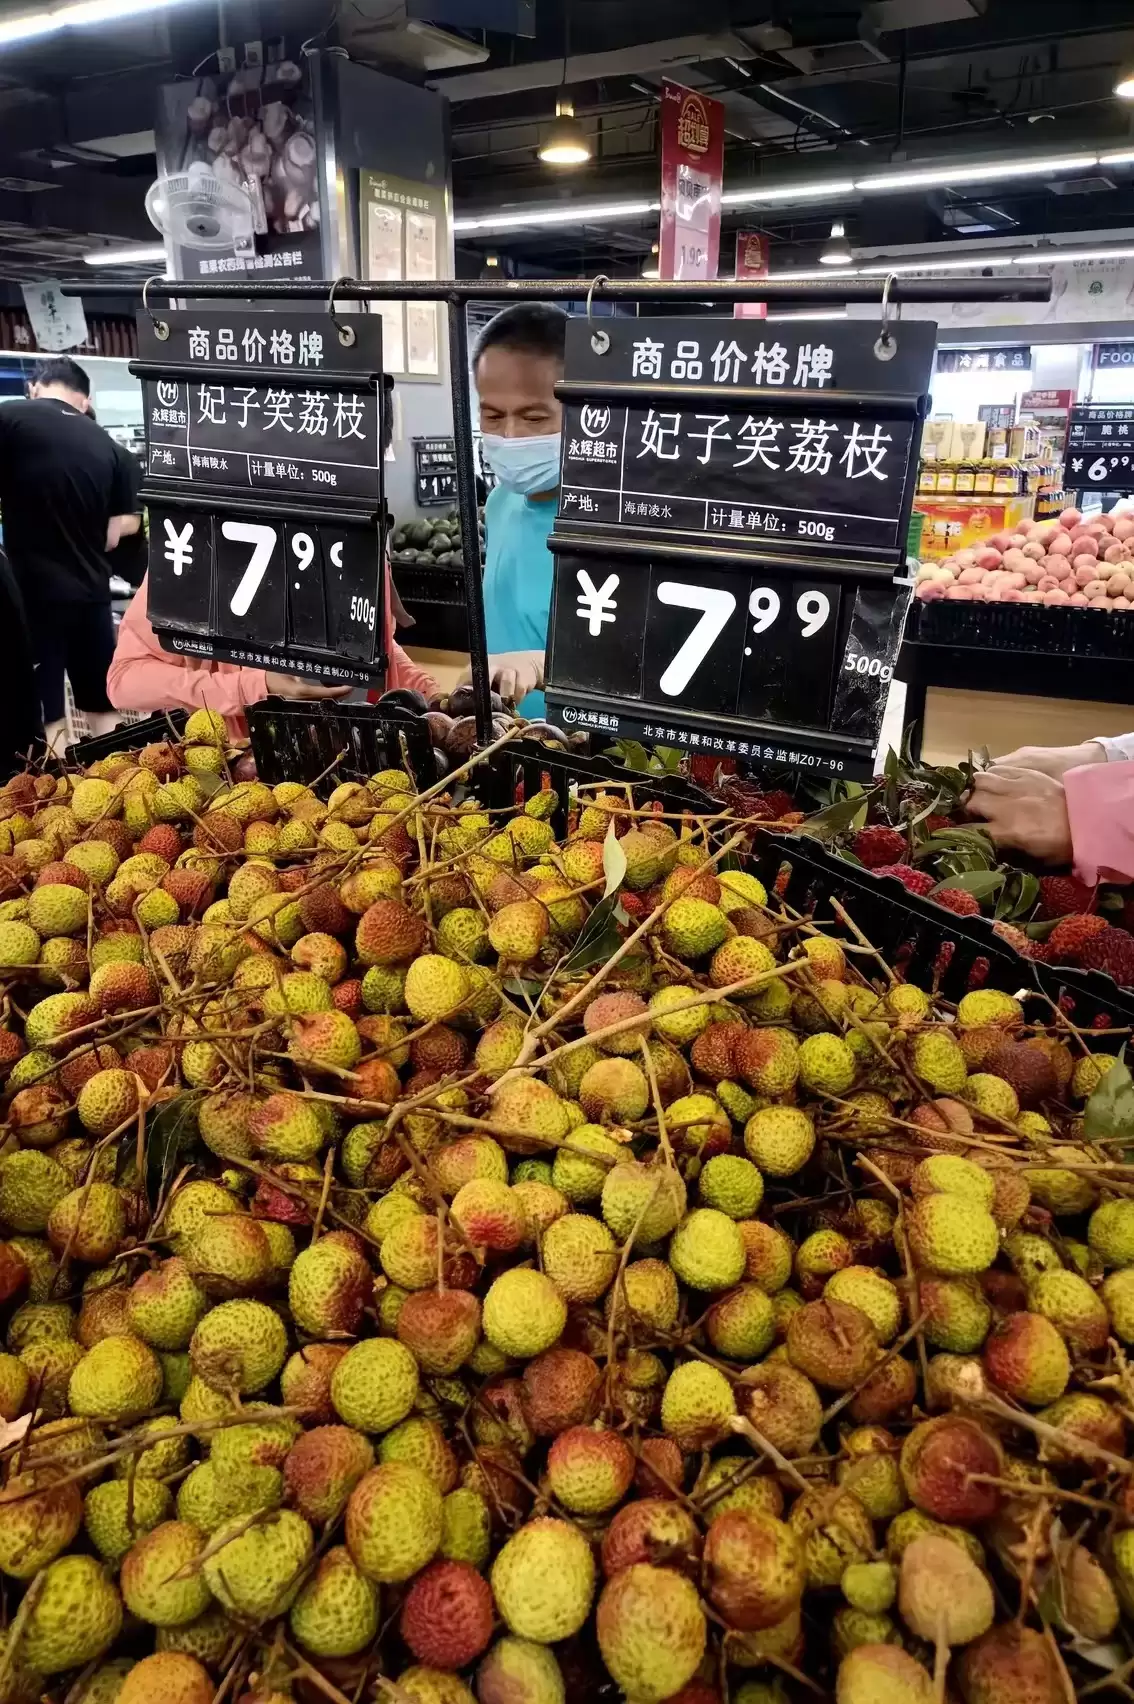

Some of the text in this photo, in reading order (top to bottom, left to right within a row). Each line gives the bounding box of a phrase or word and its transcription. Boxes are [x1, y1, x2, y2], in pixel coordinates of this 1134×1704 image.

[188, 325, 324, 367] 商品价格牌
[632, 337, 834, 388] 商品价格牌
[1100, 352, 1134, 364] FOO
[152, 408, 187, 424] 永辉超市
[197, 383, 367, 440] 妃子笑荔枝
[568, 439, 618, 458] 永辉超市
[636, 408, 893, 482] 妃子笑荔枝
[192, 455, 229, 470] 海南陵水
[312, 469, 337, 486] 500g
[624, 501, 673, 518] 海南凌水
[798, 520, 835, 542] 500g
[350, 596, 376, 631] 500g
[844, 653, 895, 684] 500g
[577, 709, 619, 727] 永辉超市
[643, 725, 844, 771] 北京市发展和改革委员会监制Z07-96
